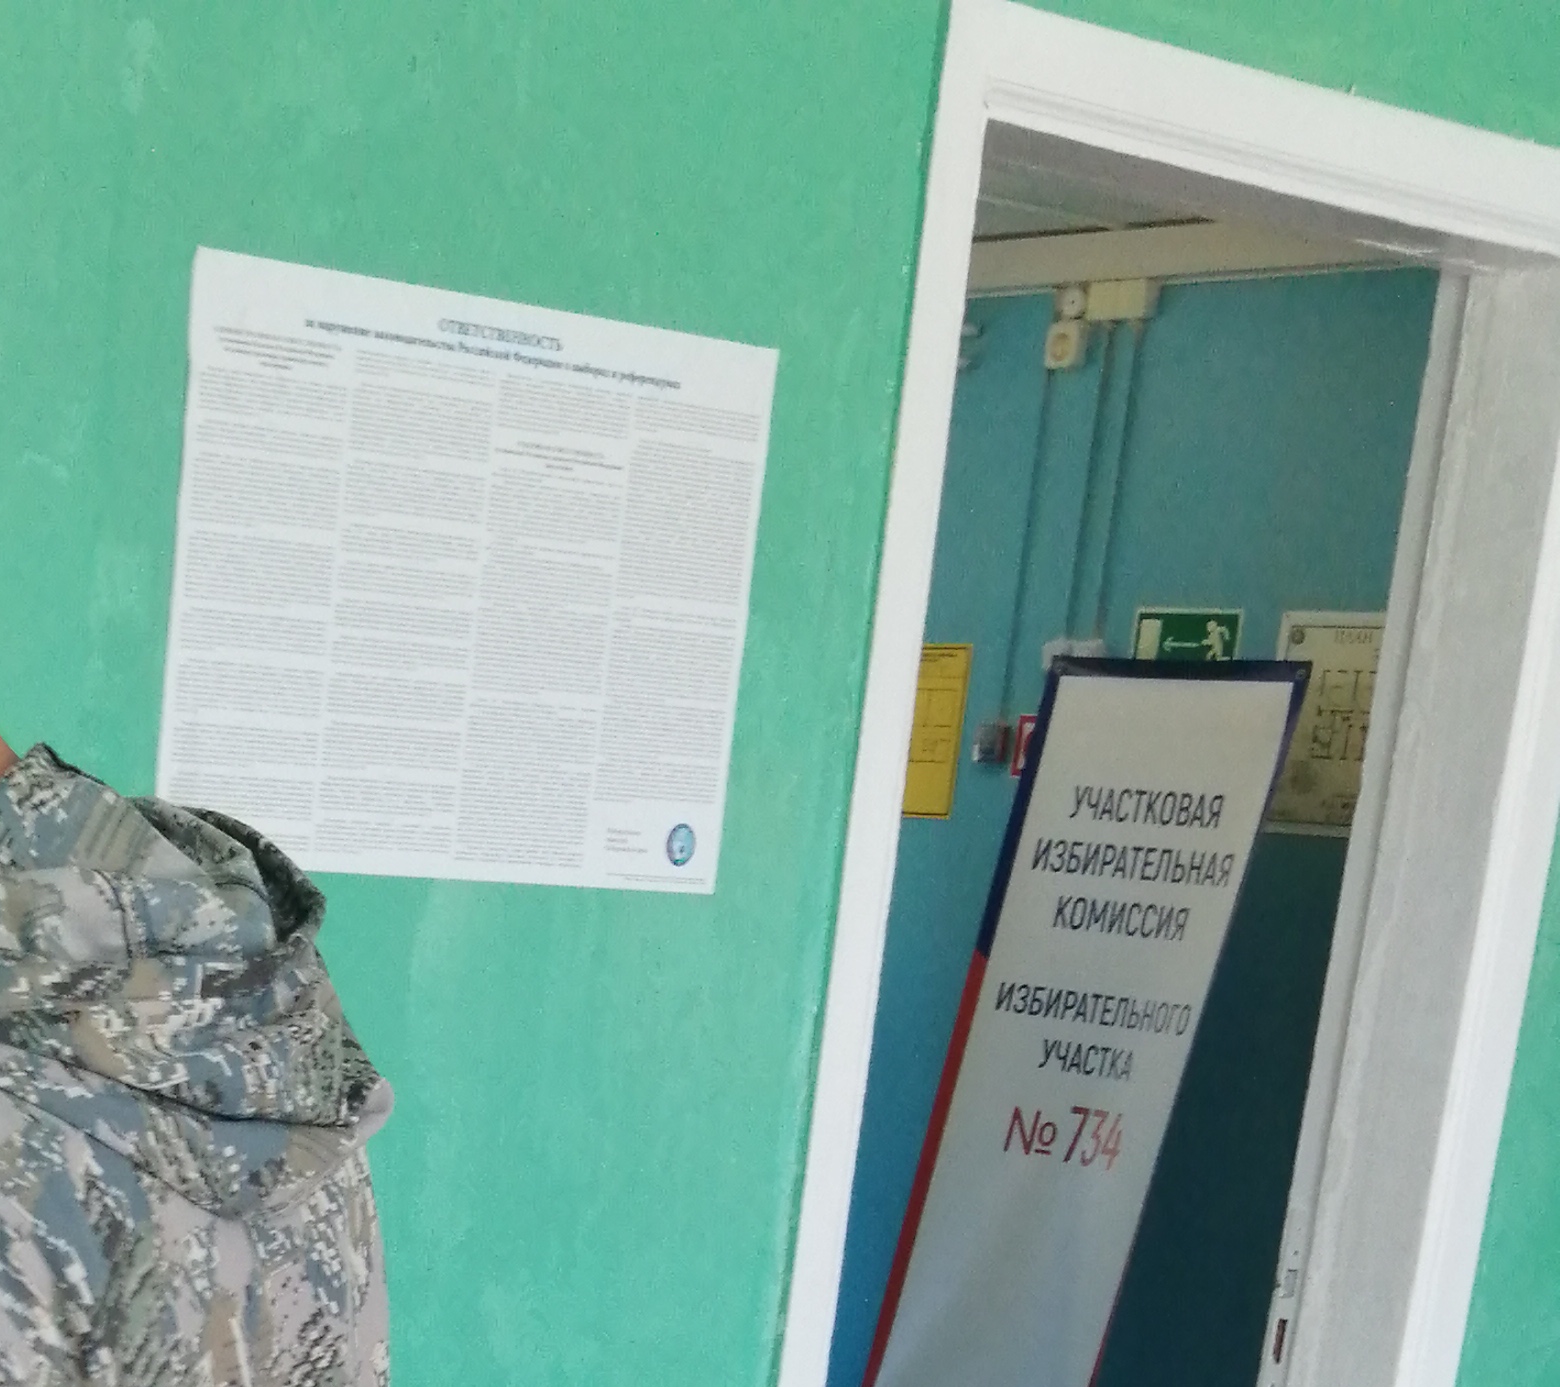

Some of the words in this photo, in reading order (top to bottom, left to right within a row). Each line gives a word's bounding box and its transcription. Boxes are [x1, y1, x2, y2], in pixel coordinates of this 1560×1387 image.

[438, 317, 564, 351] ОТВЕТСТВЕННОСТЬ
[1068, 784, 1226, 830] УЧАСТКОВАЯ
[1030, 836, 1236, 889] ИЗБИРАТЕЛЬНАЯ
[1051, 894, 1192, 942] КОМИССИЯ
[994, 981, 1193, 1037] ИЗБИРАТЕЛЬНОГО
[1037, 1037, 1135, 1082] УЧАСТКА
